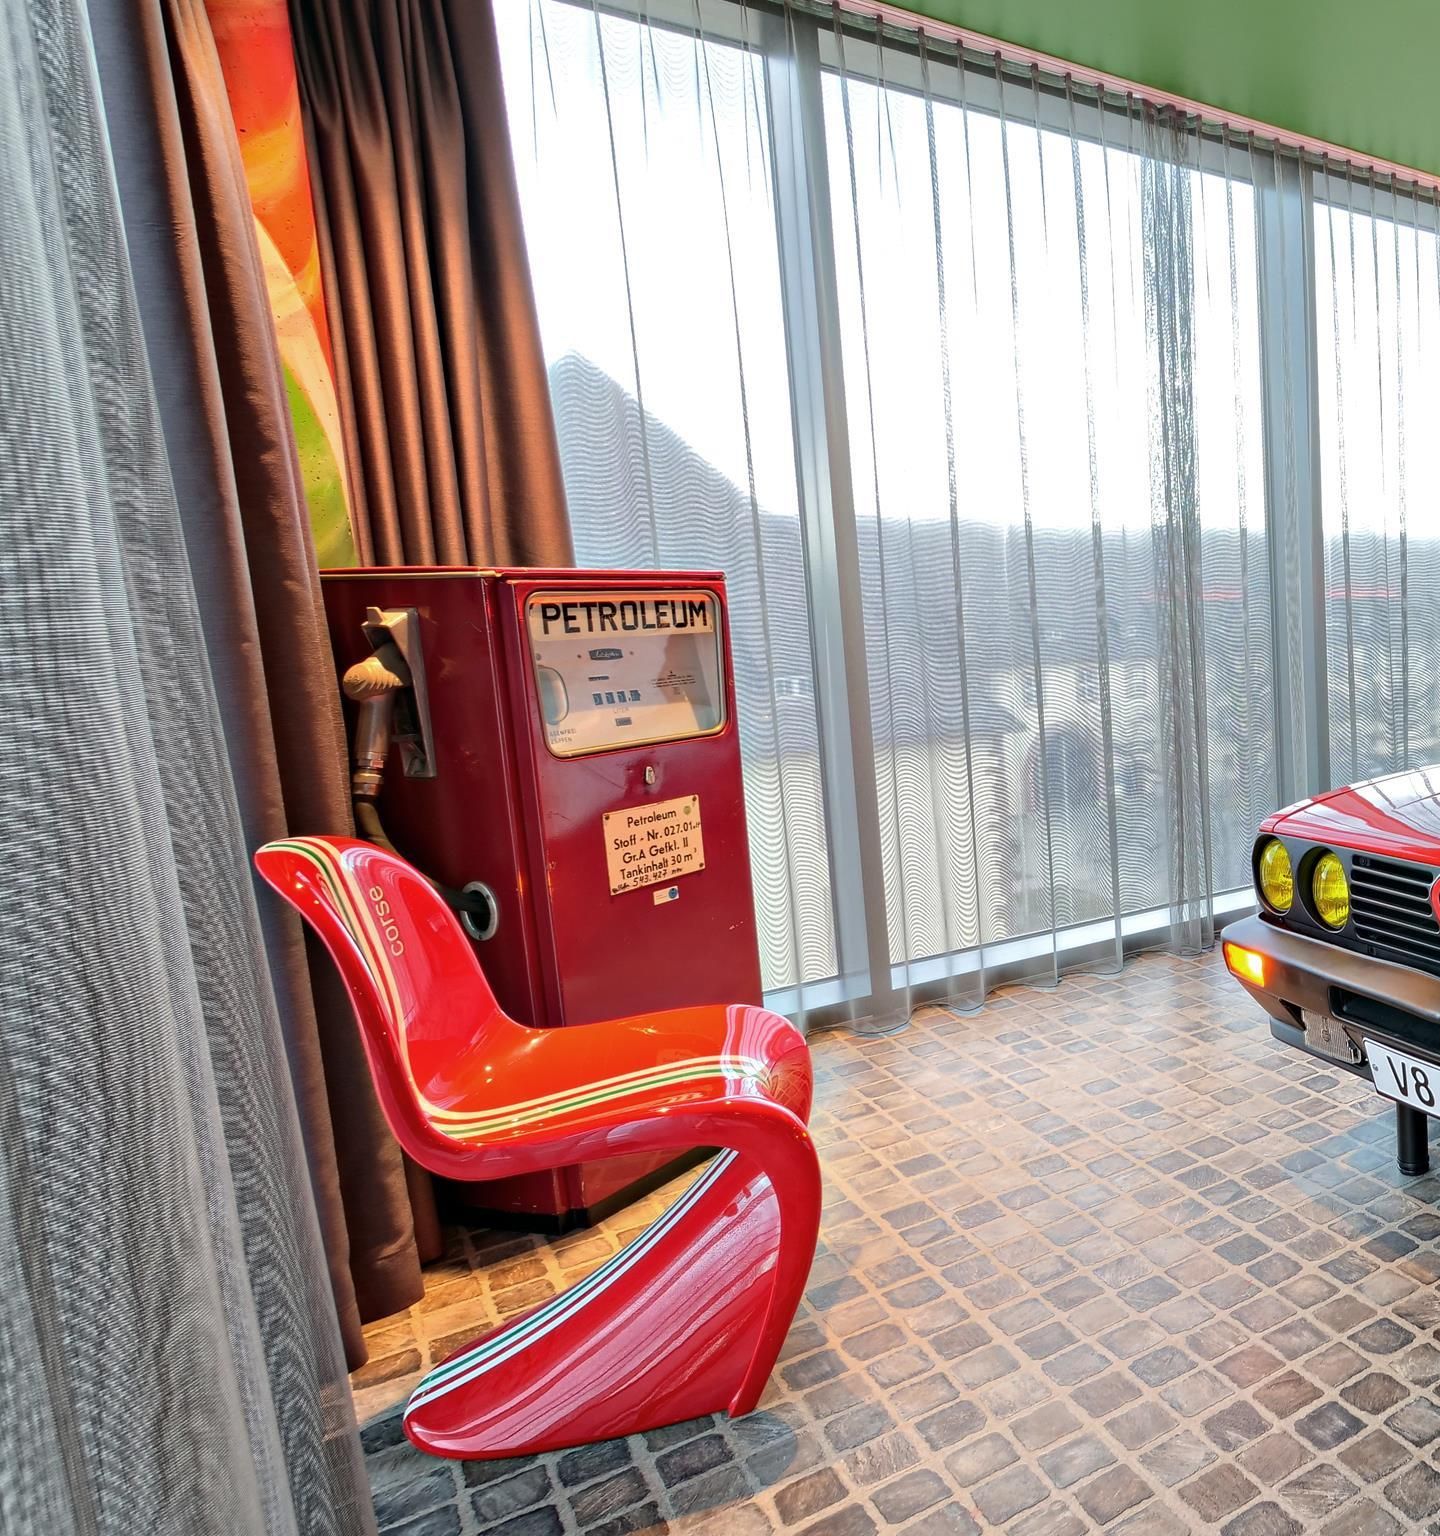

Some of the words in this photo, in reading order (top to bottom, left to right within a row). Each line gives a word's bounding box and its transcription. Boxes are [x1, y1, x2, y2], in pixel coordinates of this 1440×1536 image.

[541, 600, 708, 635] PETROLEUM
[627, 810, 677, 828] Petroleum
[614, 834, 637, 851] Stoff
[646, 829, 663, 842] Nr.
[649, 839, 680, 857] Gefkl.
[620, 857, 669, 881] Tankinhalt
[670, 853, 681, 866] 30
[369, 885, 404, 957] corse
[1386, 1055, 1436, 1108] V8
